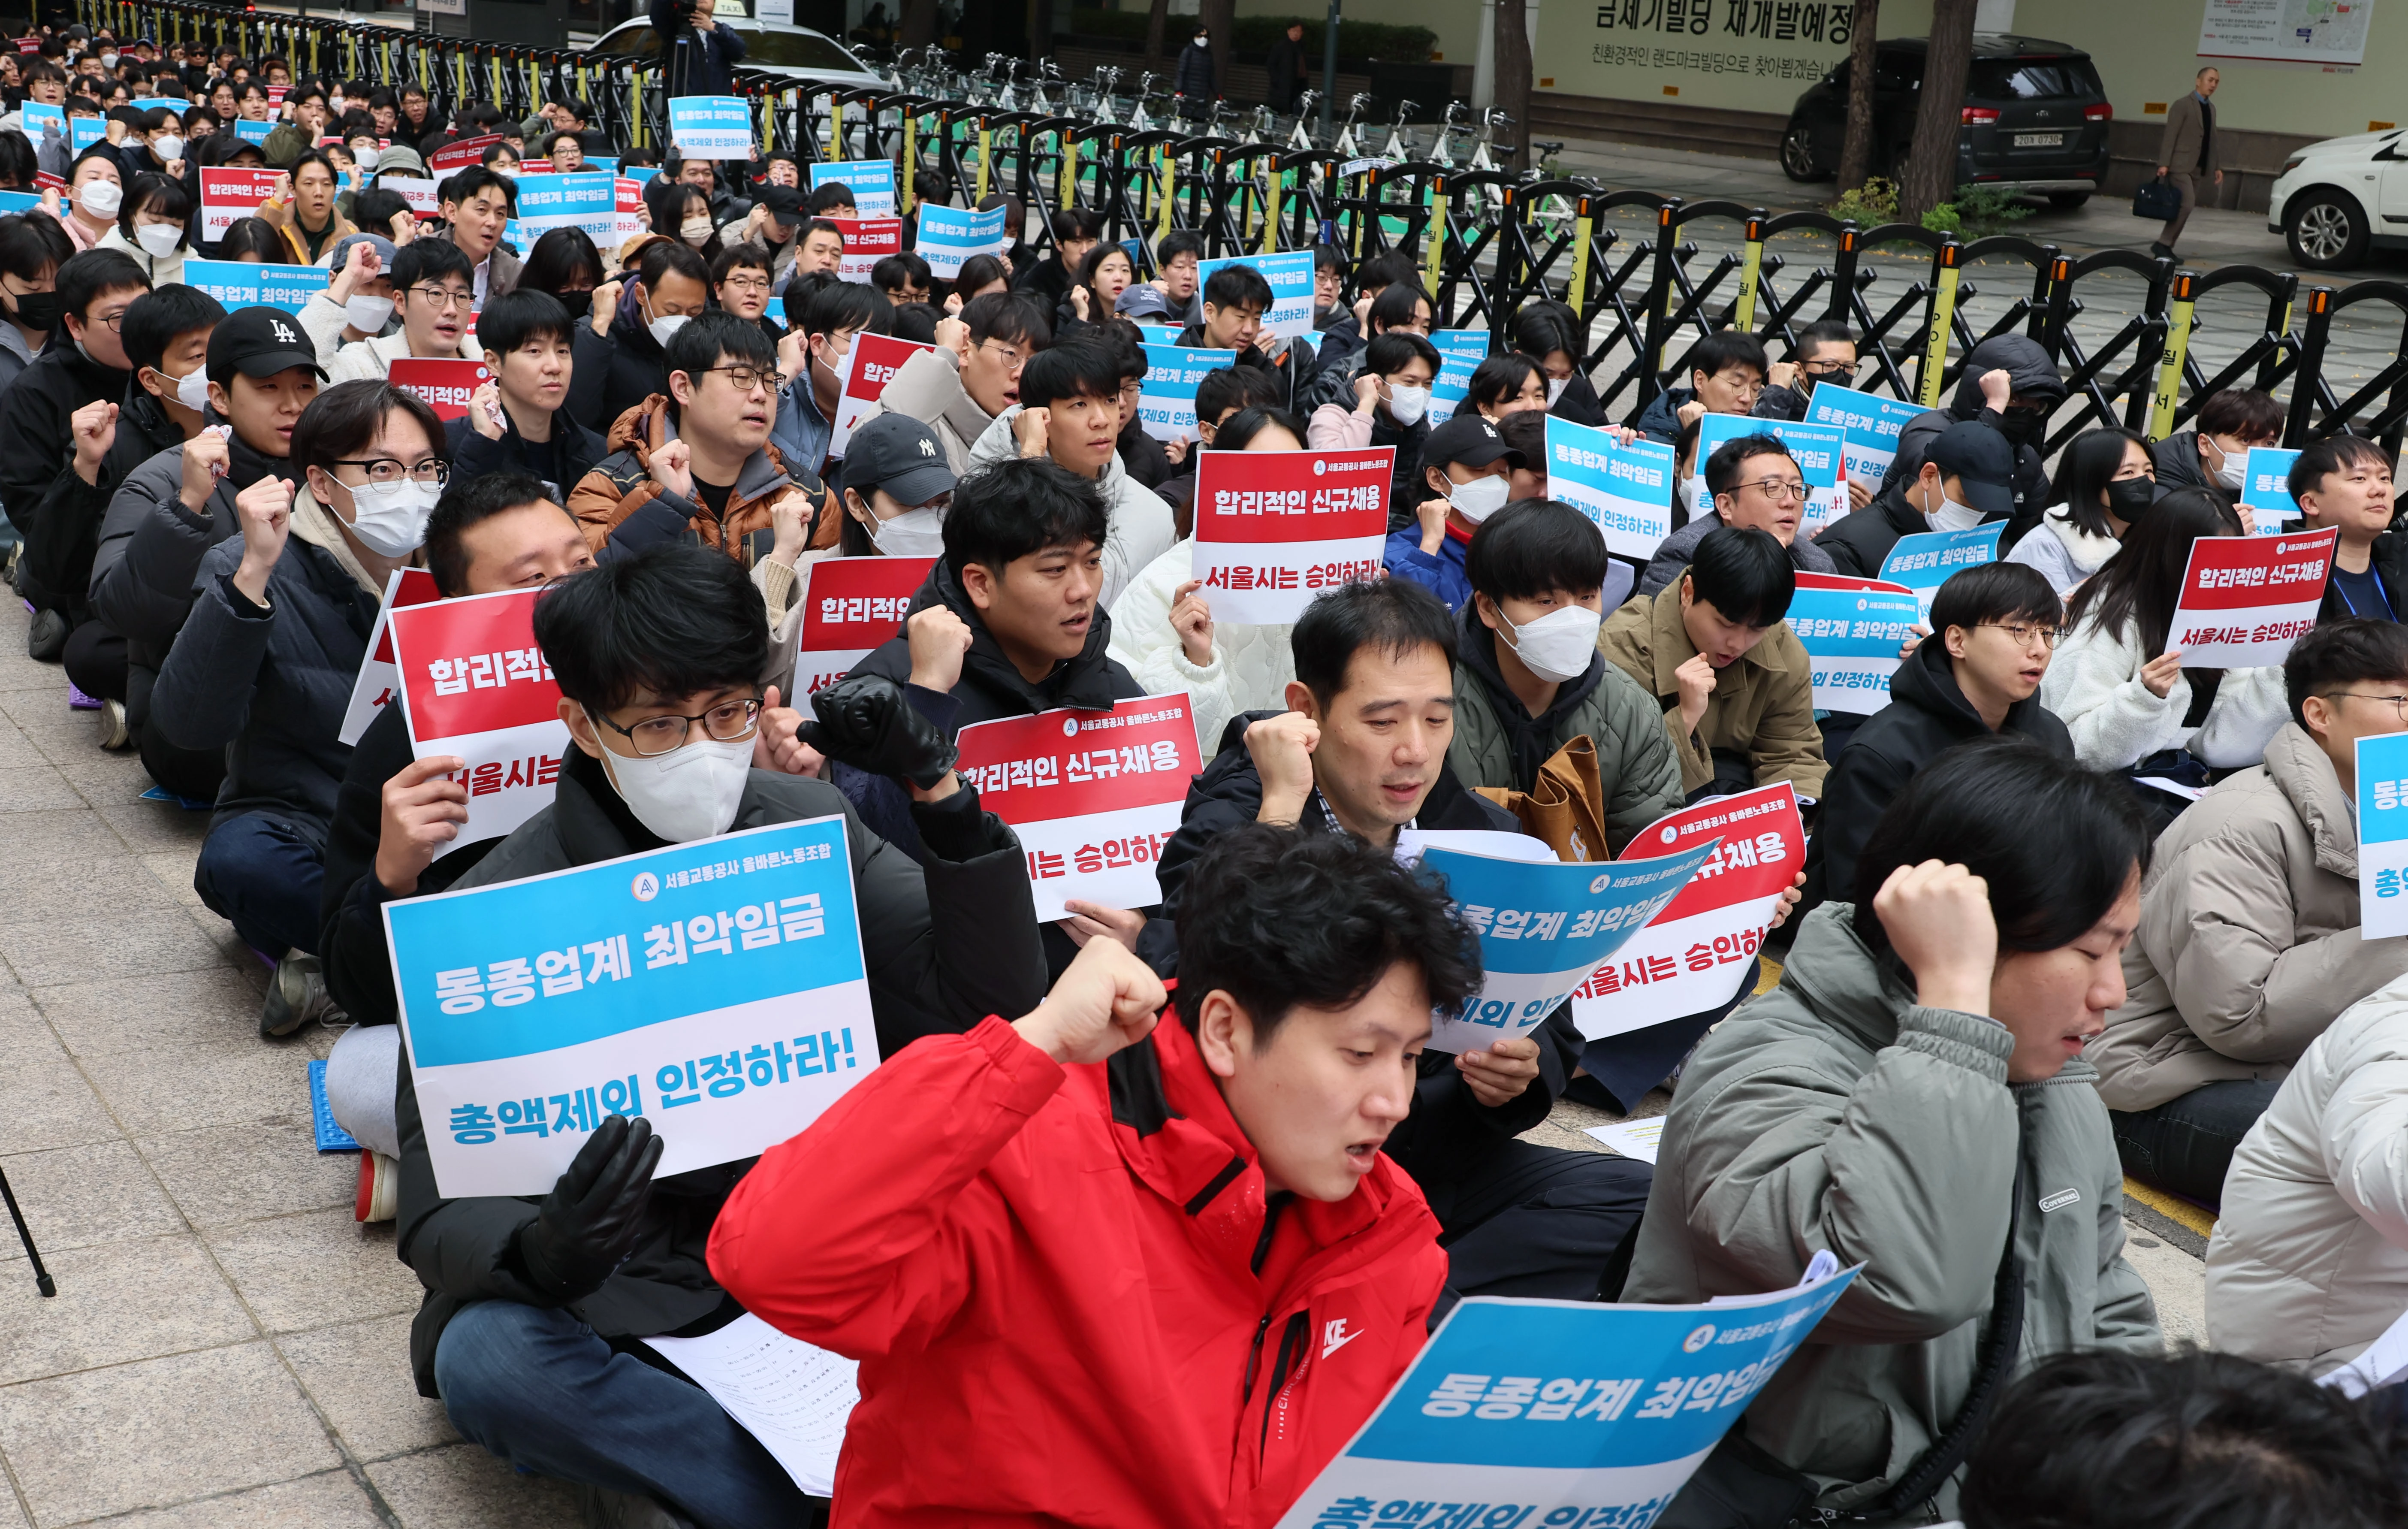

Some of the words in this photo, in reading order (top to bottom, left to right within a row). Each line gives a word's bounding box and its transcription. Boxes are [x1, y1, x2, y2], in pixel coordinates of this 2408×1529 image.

[721, 4, 742, 12] TAXI
[1722, 0, 1853, 45] 재개발예정
[1592, 43, 1649, 65] 친환경적인
[1652, 49, 1749, 74] 랜드마크빌딩으로
[1755, 55, 1840, 81] 찾아뵙겠습니
[677, 110, 712, 121] 동종업계
[714, 110, 745, 121] 최악임금
[714, 137, 751, 147] 인정하라!
[2037, 135, 2058, 145] 0730
[209, 184, 252, 196] 합리적인
[854, 173, 888, 184] 최악임금
[521, 190, 562, 206] 동종업계
[565, 189, 609, 203] 최악임금
[855, 199, 890, 210] 인정하라!
[209, 216, 235, 227] 서울
[925, 220, 967, 237] 동종업계
[969, 222, 1001, 237] 최악임금
[859, 233, 896, 245] 신규채용
[1262, 307, 1309, 323] 인정하라!
[270, 319, 297, 343] LA
[1919, 312, 1941, 406] POLICE
[1143, 366, 1182, 383] 종업계
[1817, 405, 1874, 431] 동종업계
[1328, 461, 1359, 472] 서울교통공사
[1359, 459, 1388, 470] 올바른노동조합
[1556, 443, 1607, 473] 동종업계
[1609, 455, 1663, 487] 최악임금
[1215, 490, 1307, 515] 합리적인
[1312, 484, 1380, 514] 신규채용
[1604, 510, 1662, 538] 인정하라!
[1889, 551, 1940, 573] 동종업계
[1940, 544, 1989, 565] 최악임금
[1205, 566, 1299, 590] 서울시는
[2198, 566, 2266, 589] 합리적인
[2269, 559, 2325, 585] 신규채용
[2179, 628, 2248, 646] 서울시는
[429, 648, 555, 697] 합리적
[1080, 716, 1125, 732] 서울교통공사
[1126, 707, 1183, 726] 올바른노동조합
[1065, 740, 1180, 783] 신규채용
[1679, 815, 1727, 836] 서울교통공사
[1728, 798, 1786, 825] 올바른노동조합
[1074, 831, 1177, 874] 승인하
[1688, 831, 1786, 884] 규채용
[664, 859, 739, 890] 서울교통공사
[742, 842, 832, 875] 올바른노동조합
[1611, 871, 1660, 889] 서울교통공사
[1454, 902, 1569, 942] 종업계
[435, 934, 632, 1016] 동종업계
[642, 891, 825, 970] 최악임금
[1684, 922, 1773, 973] 승인하
[449, 1073, 643, 1145] 총액제외
[655, 1026, 857, 1110] 인정하라!
[1420, 1372, 1645, 1422] 동종업계
